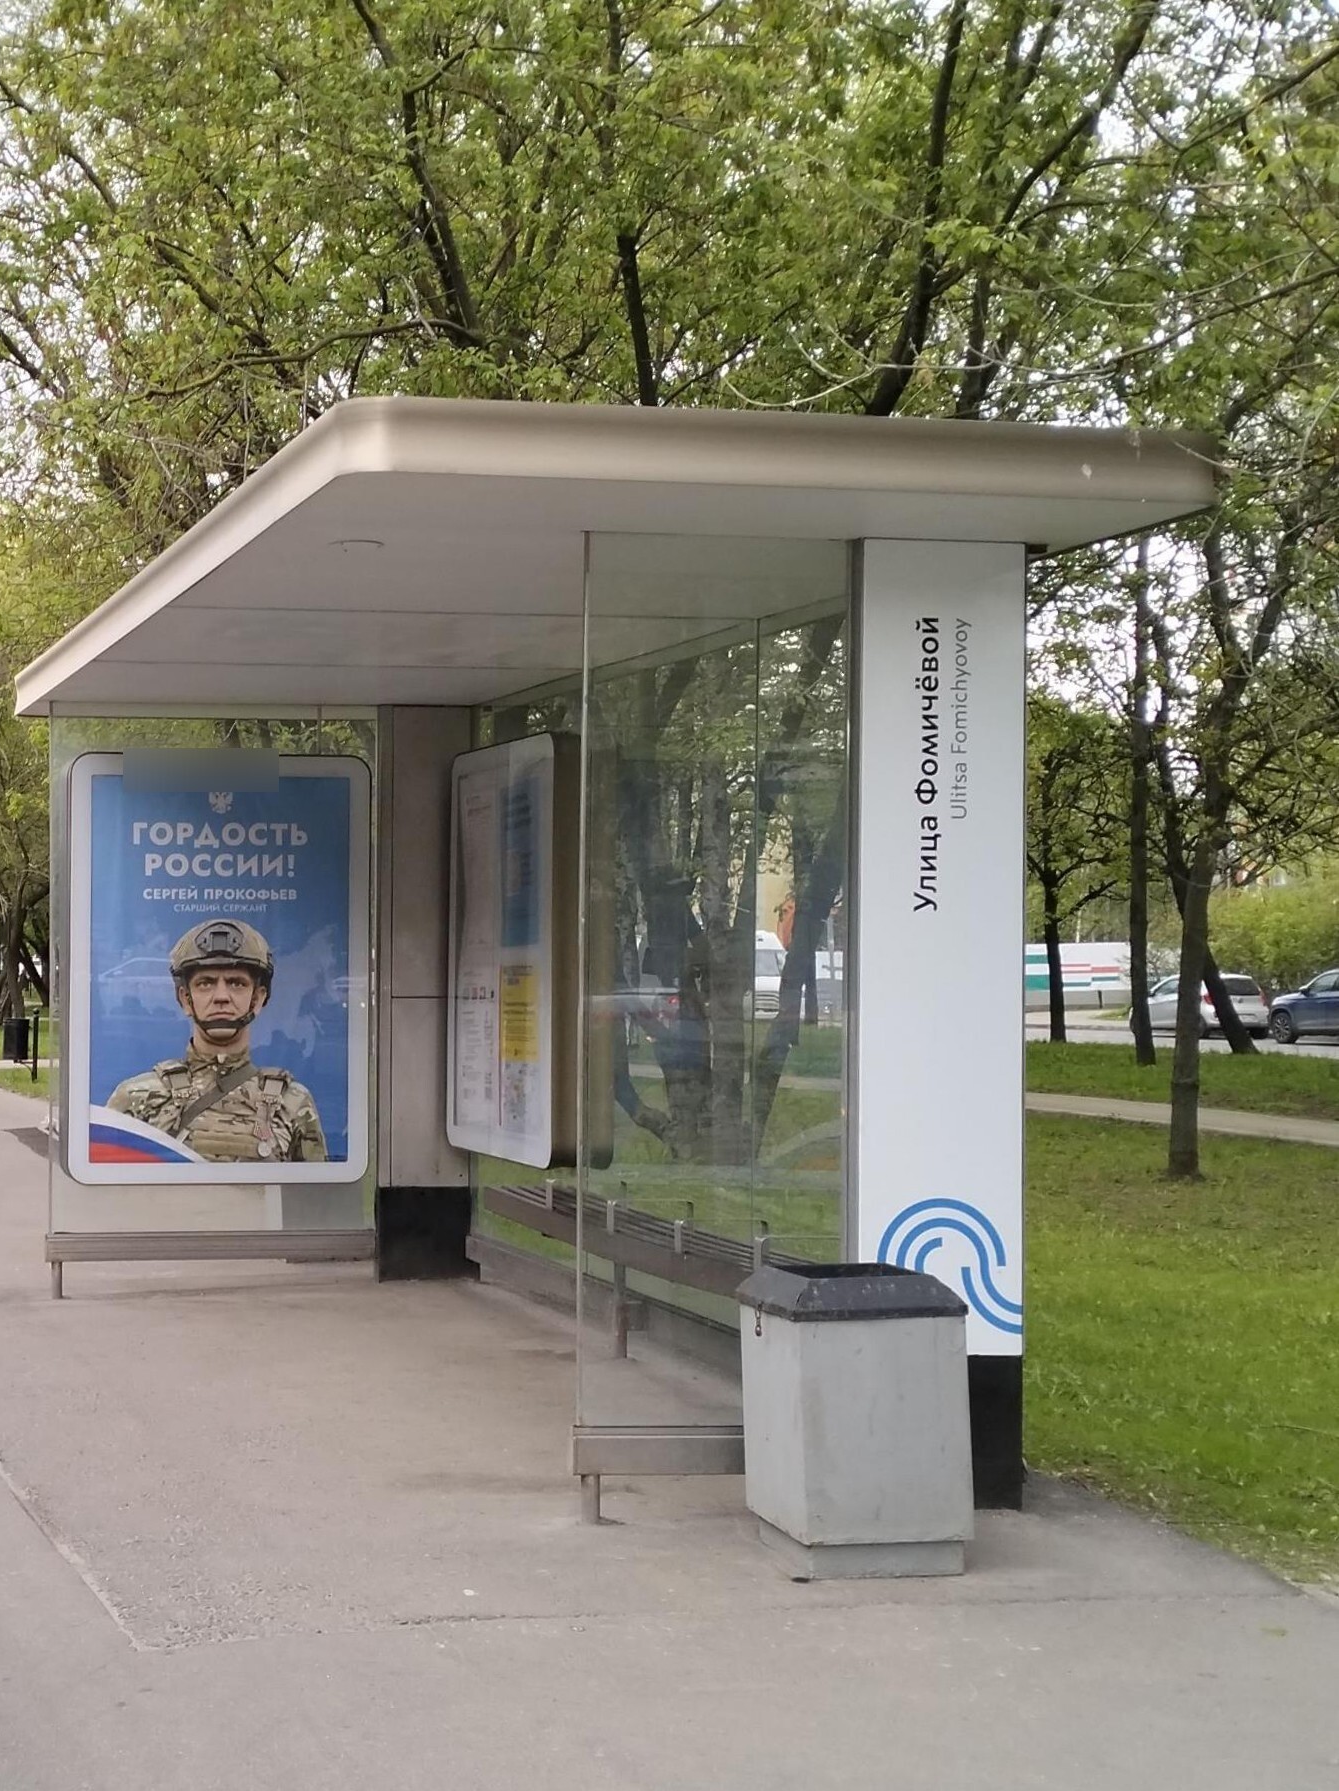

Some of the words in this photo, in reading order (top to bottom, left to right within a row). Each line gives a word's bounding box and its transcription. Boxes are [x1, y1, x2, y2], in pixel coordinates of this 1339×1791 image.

[950, 618, 972, 754] Fomichyovoy
[914, 617, 939, 805] Фомичёвой
[950, 762, 967, 820] Ulitsa
[132, 822, 308, 848] ГОРДОСТЬ
[144, 853, 295, 877] РОССИИ!
[913, 815, 941, 912] Улица
[143, 886, 198, 900] СЕРГЕЙ
[204, 888, 298, 900] ПРОКОФЬЕВ
[173, 902, 221, 913] СТАРШИЙ
[222, 903, 269, 914] СЕРЖАНТ
